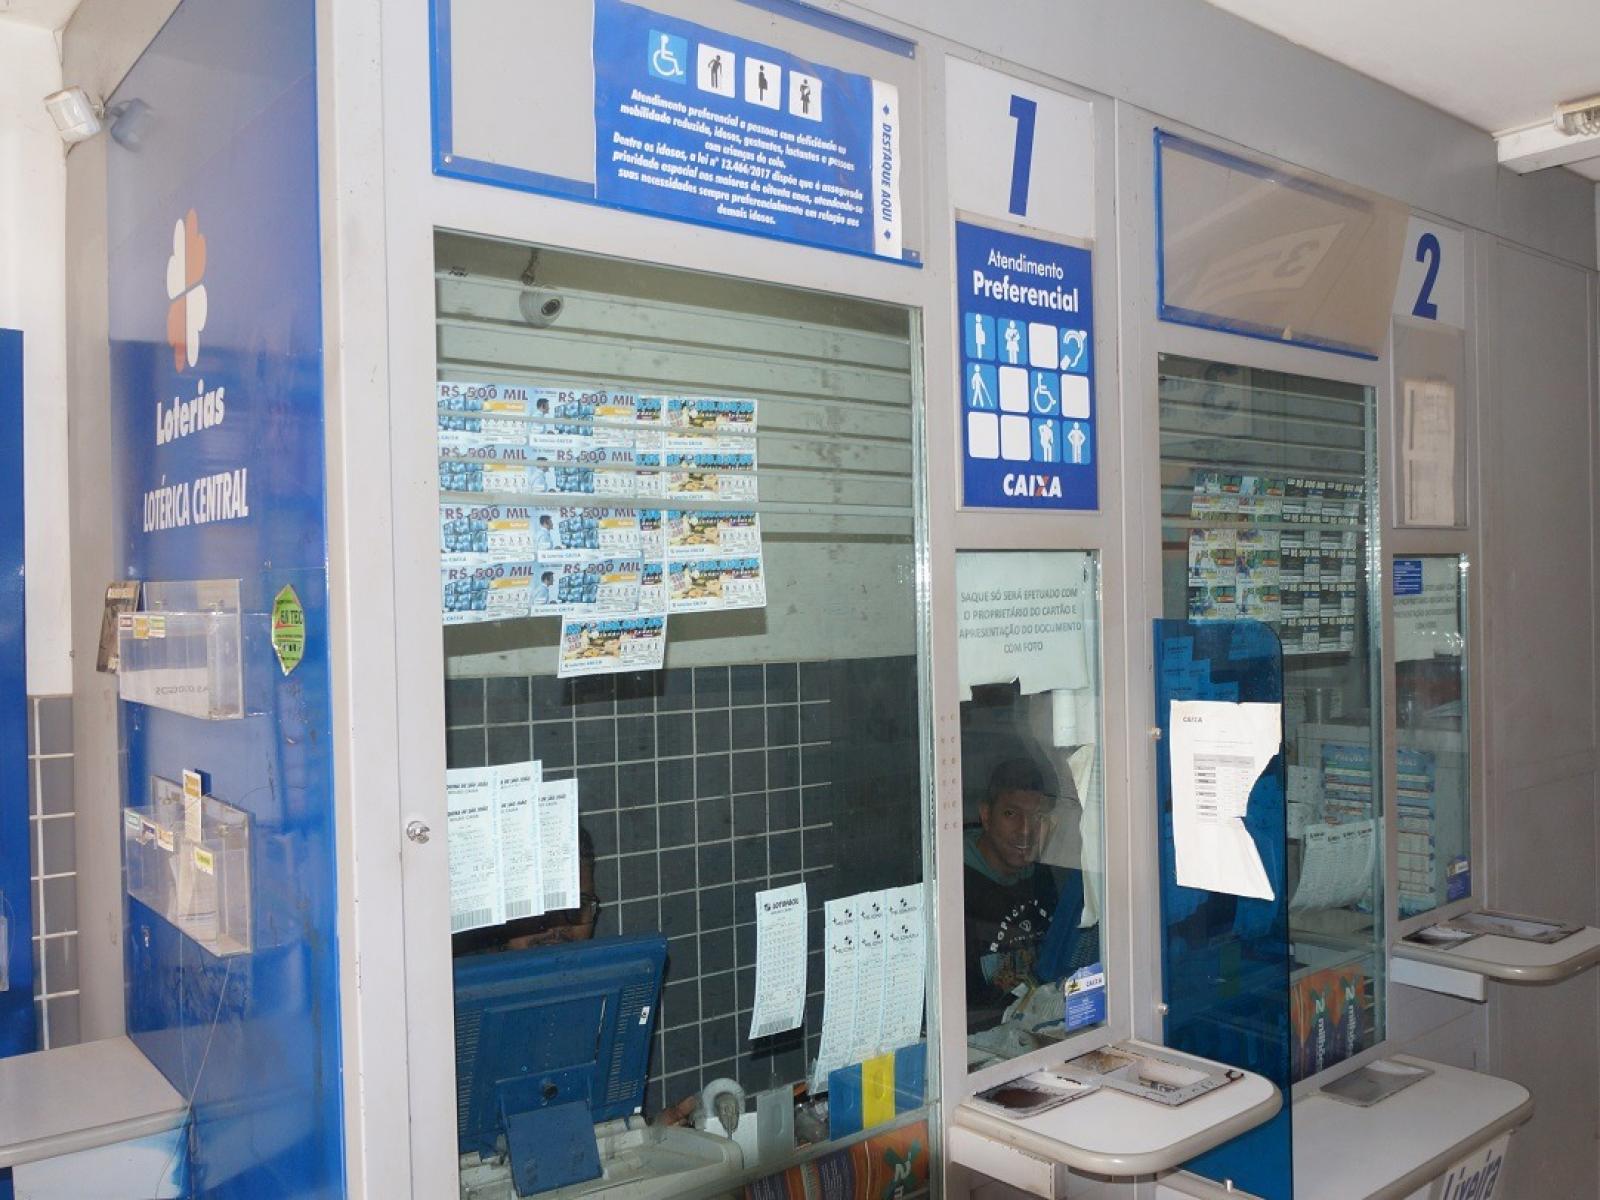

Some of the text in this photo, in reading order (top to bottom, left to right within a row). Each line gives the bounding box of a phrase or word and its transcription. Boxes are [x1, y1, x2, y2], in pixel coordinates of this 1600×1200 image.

[631, 88, 687, 113] Atendimento
[687, 106, 739, 127] preferencial
[740, 121, 746, 129] a
[747, 123, 779, 138] pessoas
[780, 131, 795, 142] com
[620, 104, 672, 125] mobilidade
[828, 157, 855, 171] pessoas
[613, 131, 642, 150] Dentre
[644, 143, 654, 153] os
[656, 142, 687, 161] idosos,
[689, 153, 696, 162] a
[698, 152, 709, 165] lei
[799, 180, 814, 190] que
[815, 179, 820, 191] é
[821, 184, 863, 201] assegurada
[705, 142, 721, 153] com
[756, 152, 766, 164] de
[768, 156, 786, 168] colo.
[1009, 95, 1037, 216] 1
[612, 150, 660, 170] prioridade
[661, 164, 698, 179] especial
[699, 171, 714, 182] aos
[715, 174, 749, 190] maiores
[751, 180, 761, 192] de
[762, 183, 791, 199] oitenta
[881, 123, 893, 223] DESTAQUE AQUI
[618, 168, 639, 181] suas
[641, 174, 697, 195] necessidades
[699, 187, 730, 201] sempre
[731, 191, 804, 216] preferencialmente
[805, 209, 817, 219] em
[716, 203, 776, 225] demais idosos.
[987, 248, 1064, 280] Atendimento
[1412, 233, 1441, 320] 2
[972, 270, 1079, 313] Preferencial
[467, 386, 498, 399] 500
[504, 389, 528, 401] MIL
[580, 393, 608, 405] 500
[613, 395, 635, 406] MIL
[156, 378, 225, 446] Loterias
[503, 449, 527, 460] MIL
[580, 450, 607, 461] 500
[611, 451, 634, 461] MIL
[1003, 473, 1062, 498] CAIXA
[143, 467, 249, 533] LOTÉRICA CENTRAL
[470, 507, 500, 520] 500
[506, 507, 530, 519] MIL
[582, 507, 610, 519] 500
[614, 508, 636, 518] MIL
[475, 566, 505, 579] 500
[510, 566, 534, 577] MIL
[587, 562, 614, 575] 500
[619, 561, 641, 573] MIL
[961, 587, 1078, 604] SAQUE SÓ SERÁ EFETUADO COM
[964, 604, 1077, 621] O PROPRIETÁRIO DO CARTÃO E
[959, 622, 1082, 639] APRESENTAÇÃO DO DOCUMENTO
[1004, 641, 1043, 654] COM FOTO
